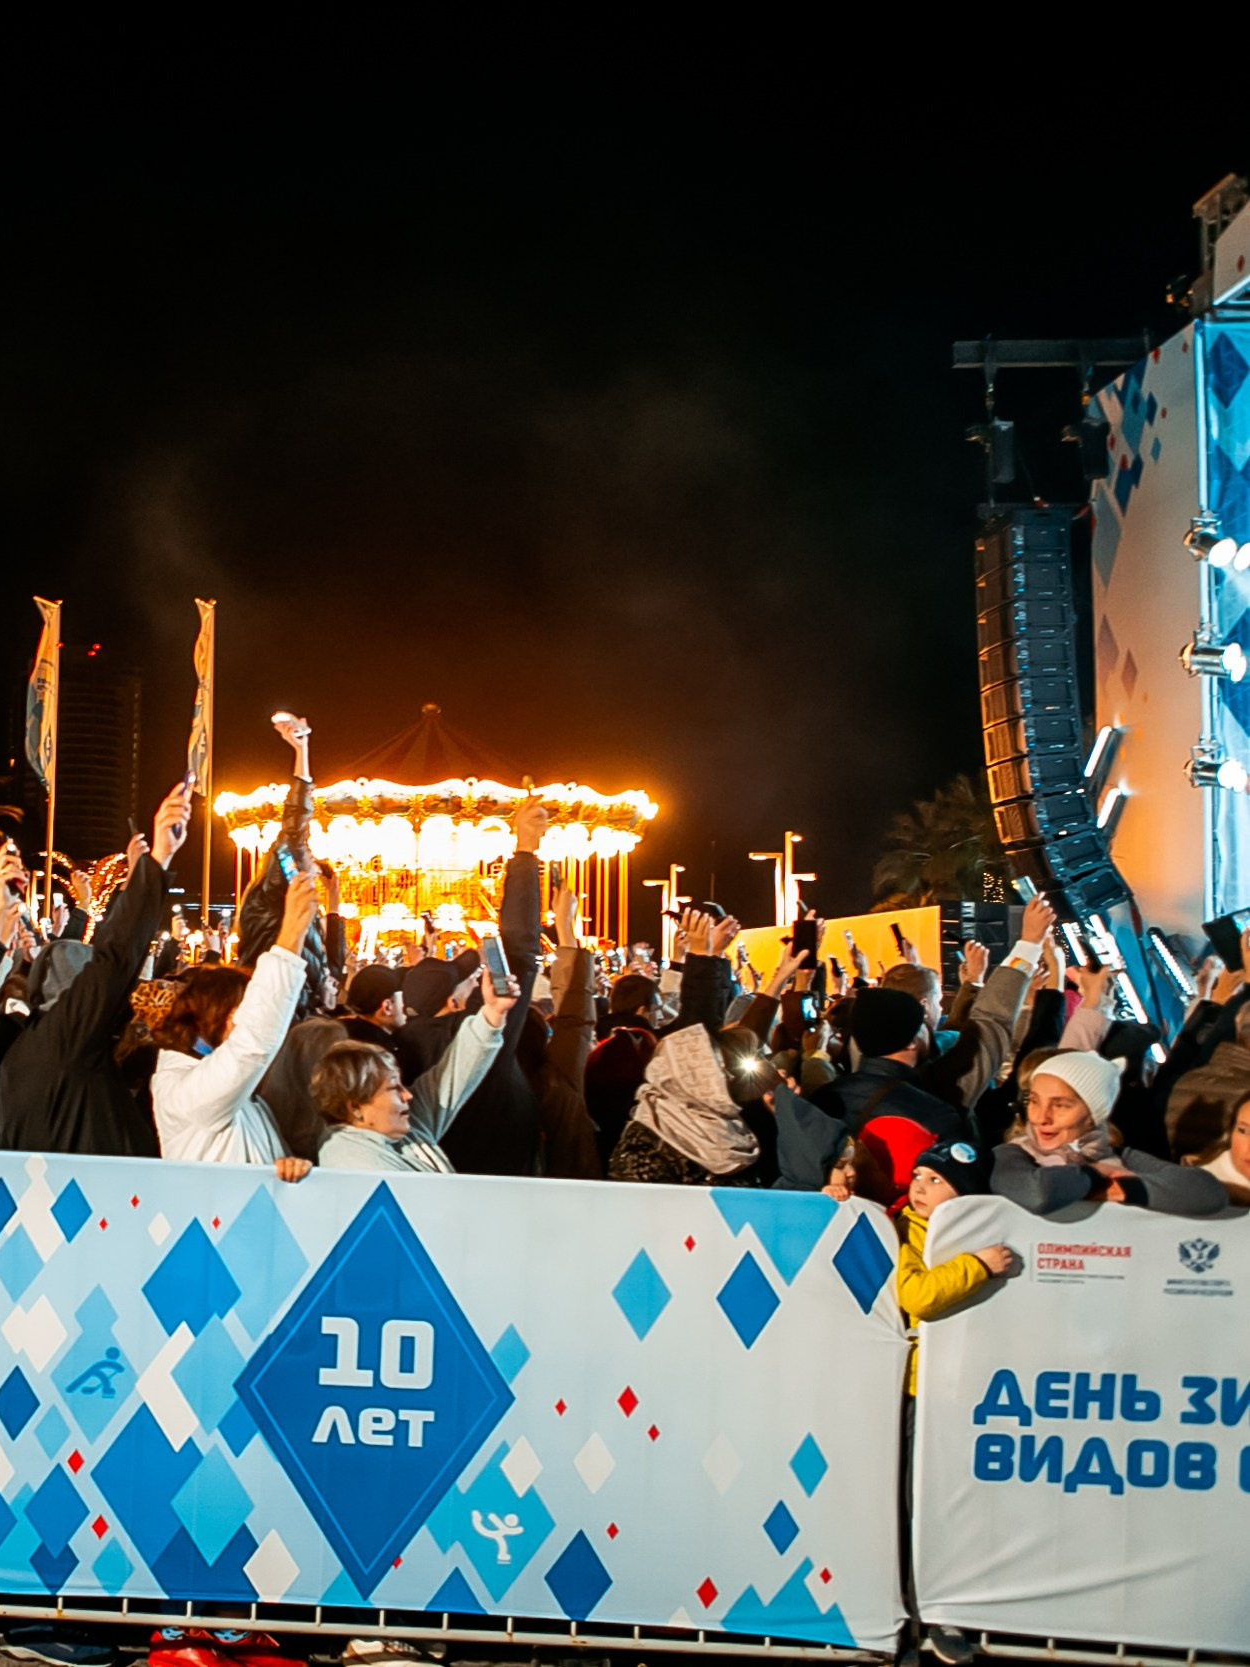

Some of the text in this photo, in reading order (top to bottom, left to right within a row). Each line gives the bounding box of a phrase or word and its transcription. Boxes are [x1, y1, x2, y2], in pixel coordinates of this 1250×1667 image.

[1037, 1242, 1132, 1259] ОЛИМПИЙСКАЯ
[1037, 1257, 1086, 1271] СТРАНА
[318, 1315, 435, 1390] 10
[972, 1368, 1162, 1427] ДЕНЬ
[973, 1433, 1218, 1495] ВИДОВ
